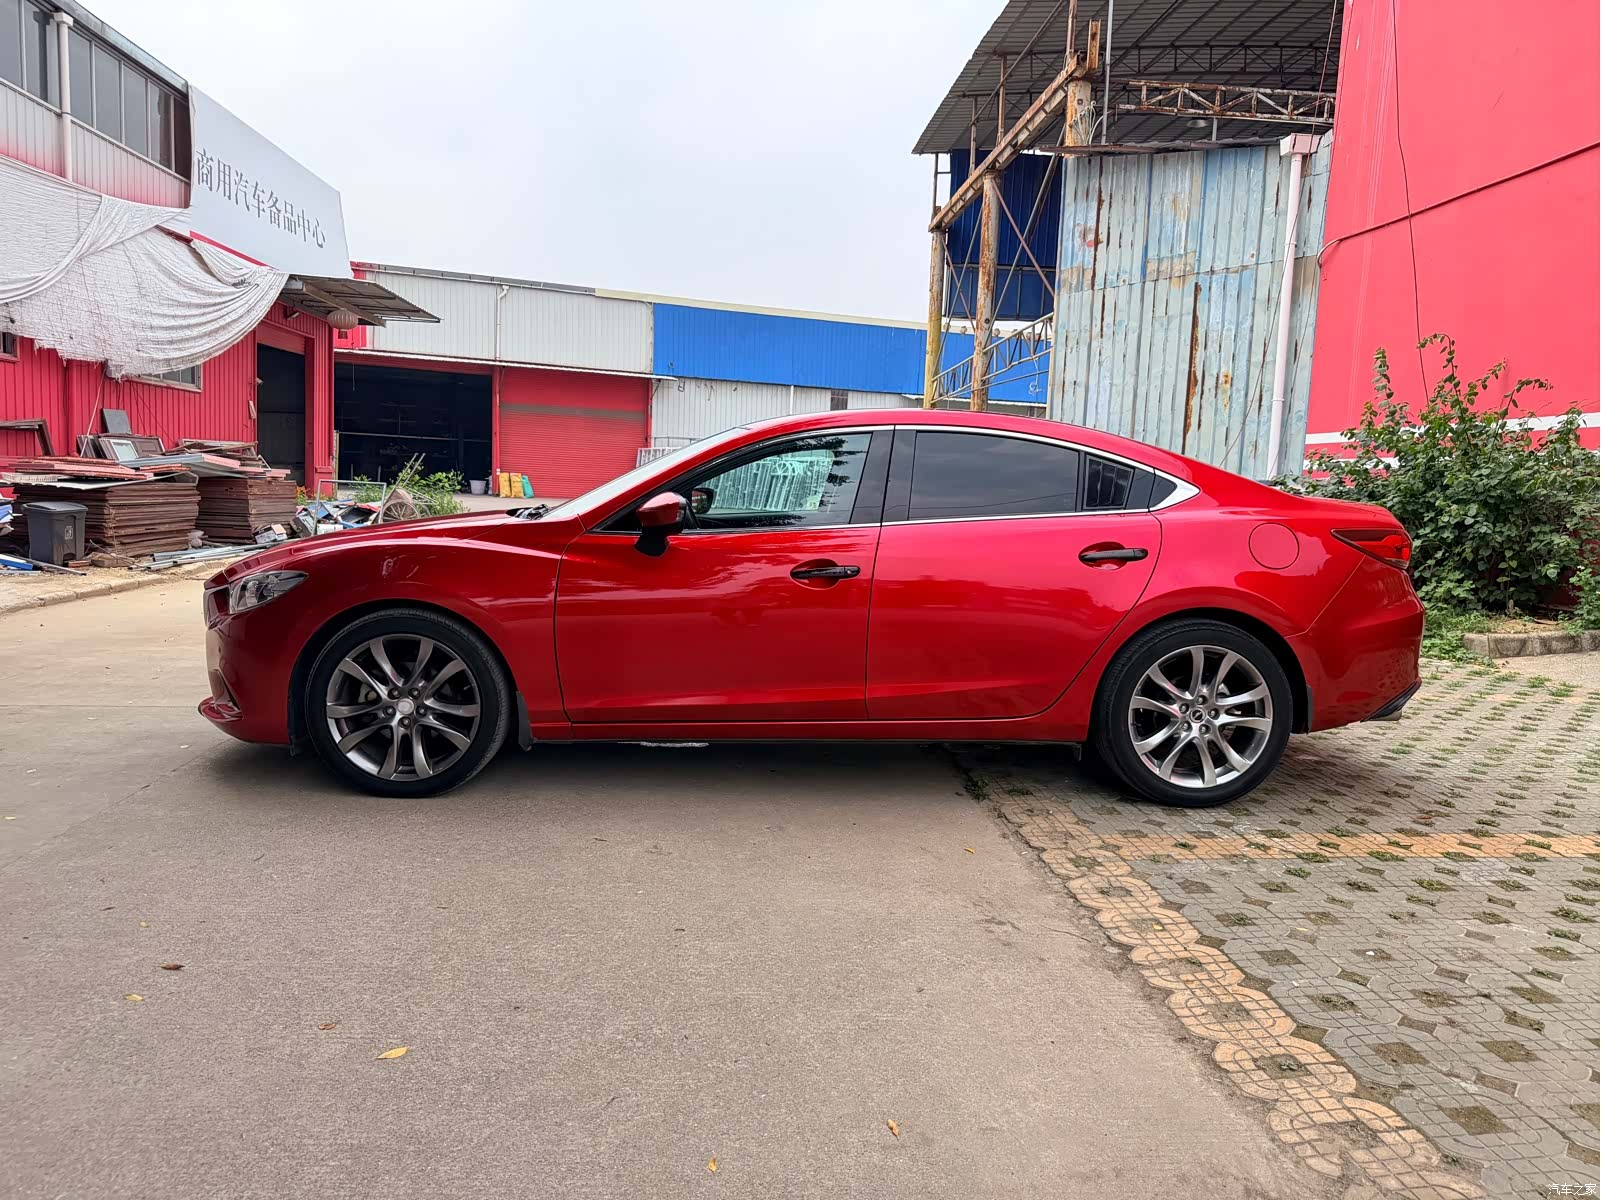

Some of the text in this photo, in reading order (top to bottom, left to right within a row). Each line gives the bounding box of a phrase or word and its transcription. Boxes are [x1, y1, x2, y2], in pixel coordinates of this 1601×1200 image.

[196, 148, 326, 248] 商用汽车备品中心
